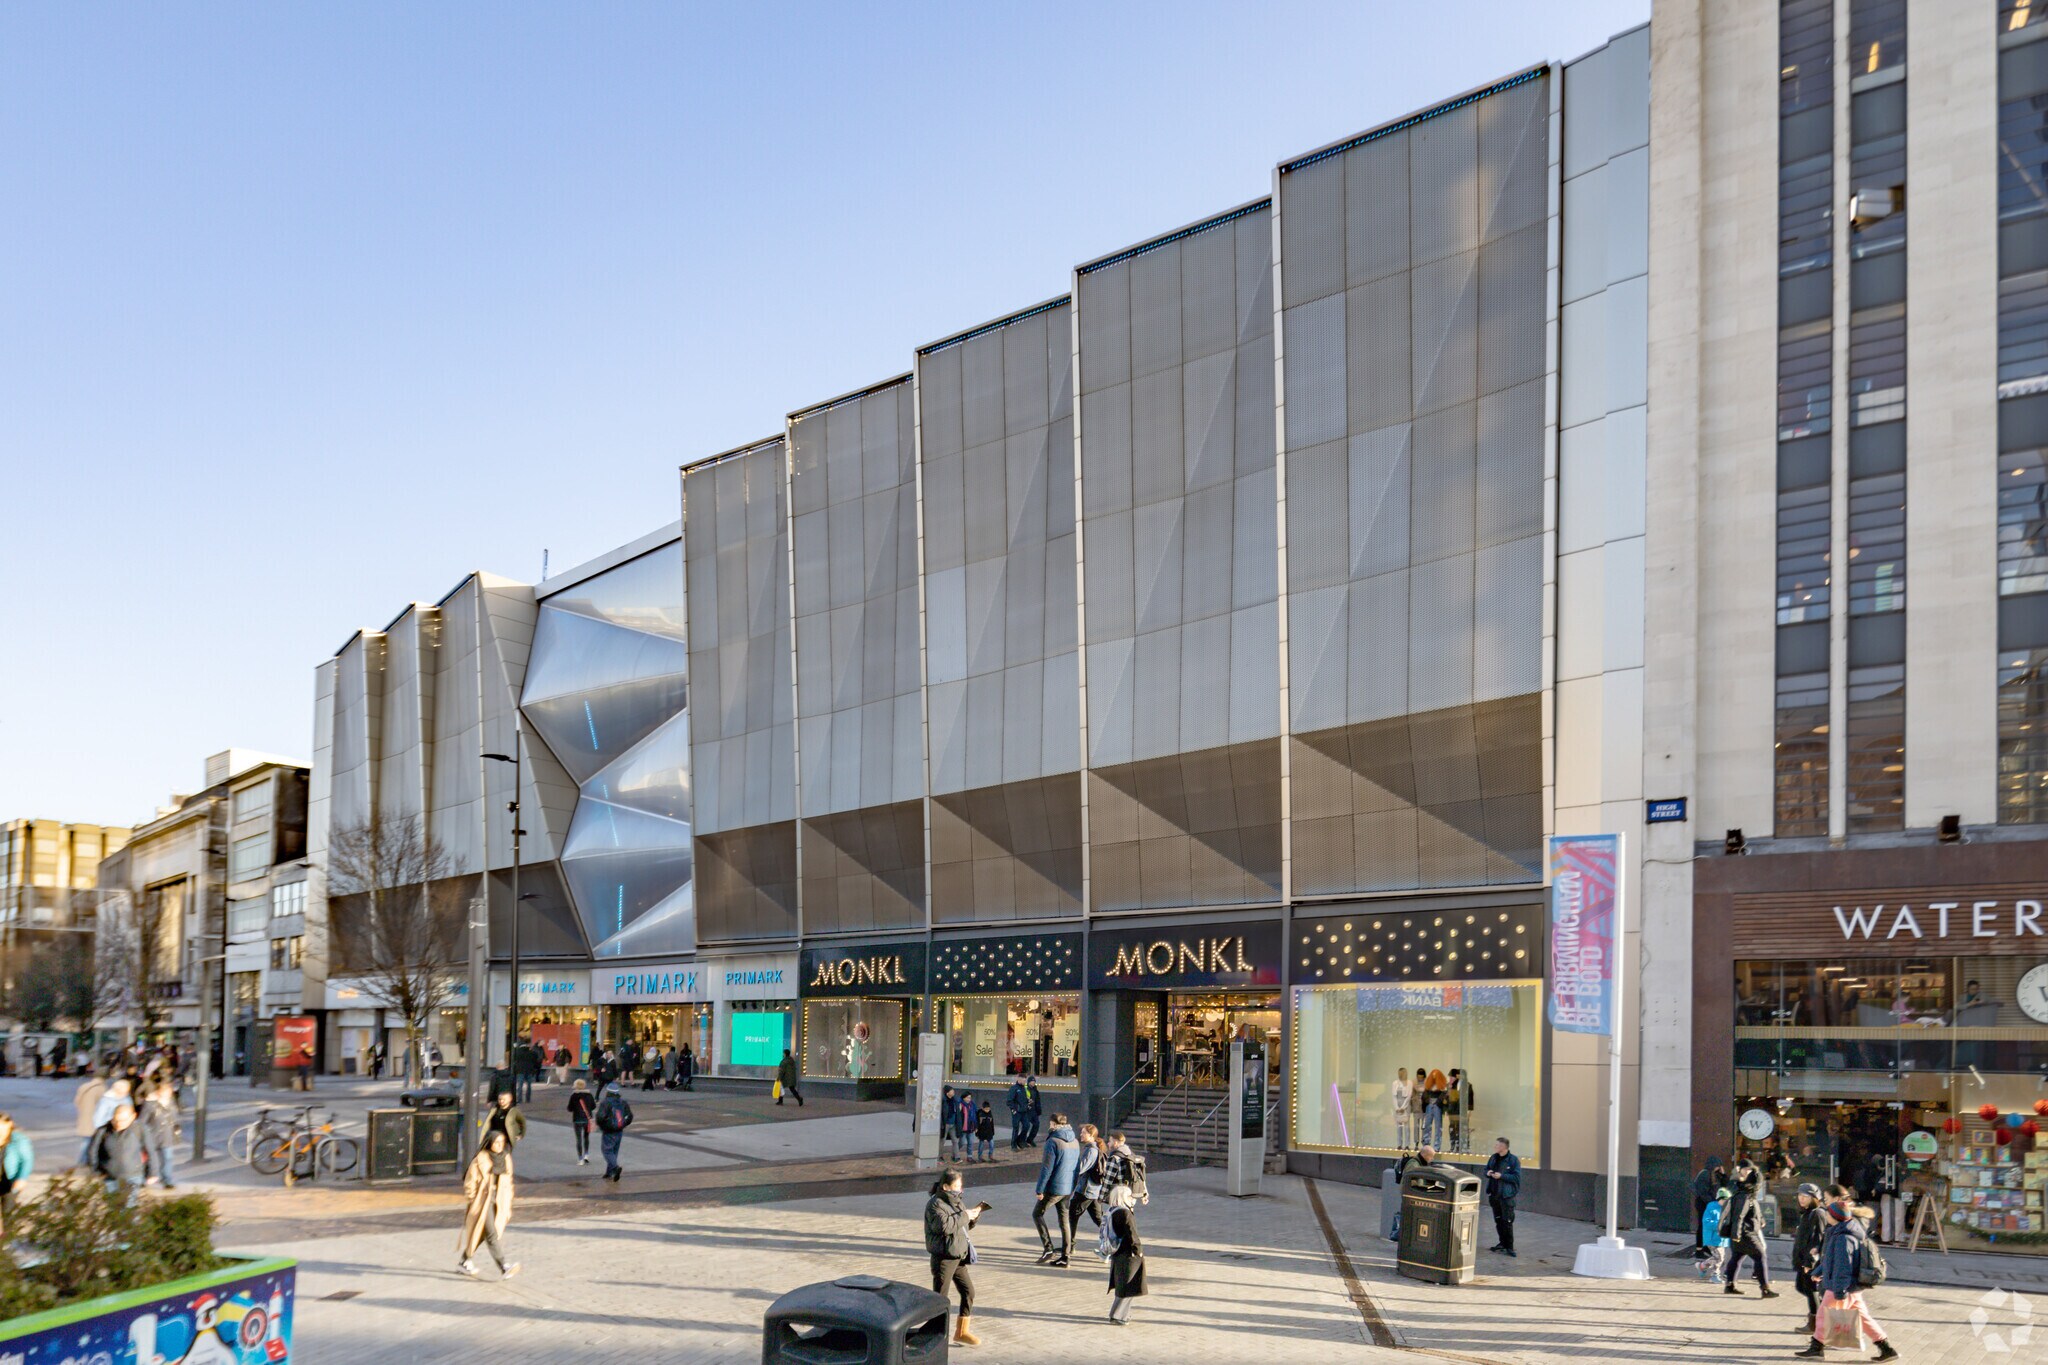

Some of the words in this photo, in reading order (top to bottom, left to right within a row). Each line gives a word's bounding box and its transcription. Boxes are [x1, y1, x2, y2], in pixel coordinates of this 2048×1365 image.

[1655, 803, 1678, 811] HIGH
[1650, 809, 1682, 818] STREET
[1832, 900, 2046, 940] WATER
[614, 972, 699, 995] PRIMARK
[725, 969, 783, 986] PRIMARK
[519, 981, 577, 995] PRIMARK
[976, 1044, 993, 1056] Sale
[1014, 1045, 1033, 1057] Sale
[1053, 1044, 1072, 1057] Sale
[1748, 1119, 1764, 1130] W
